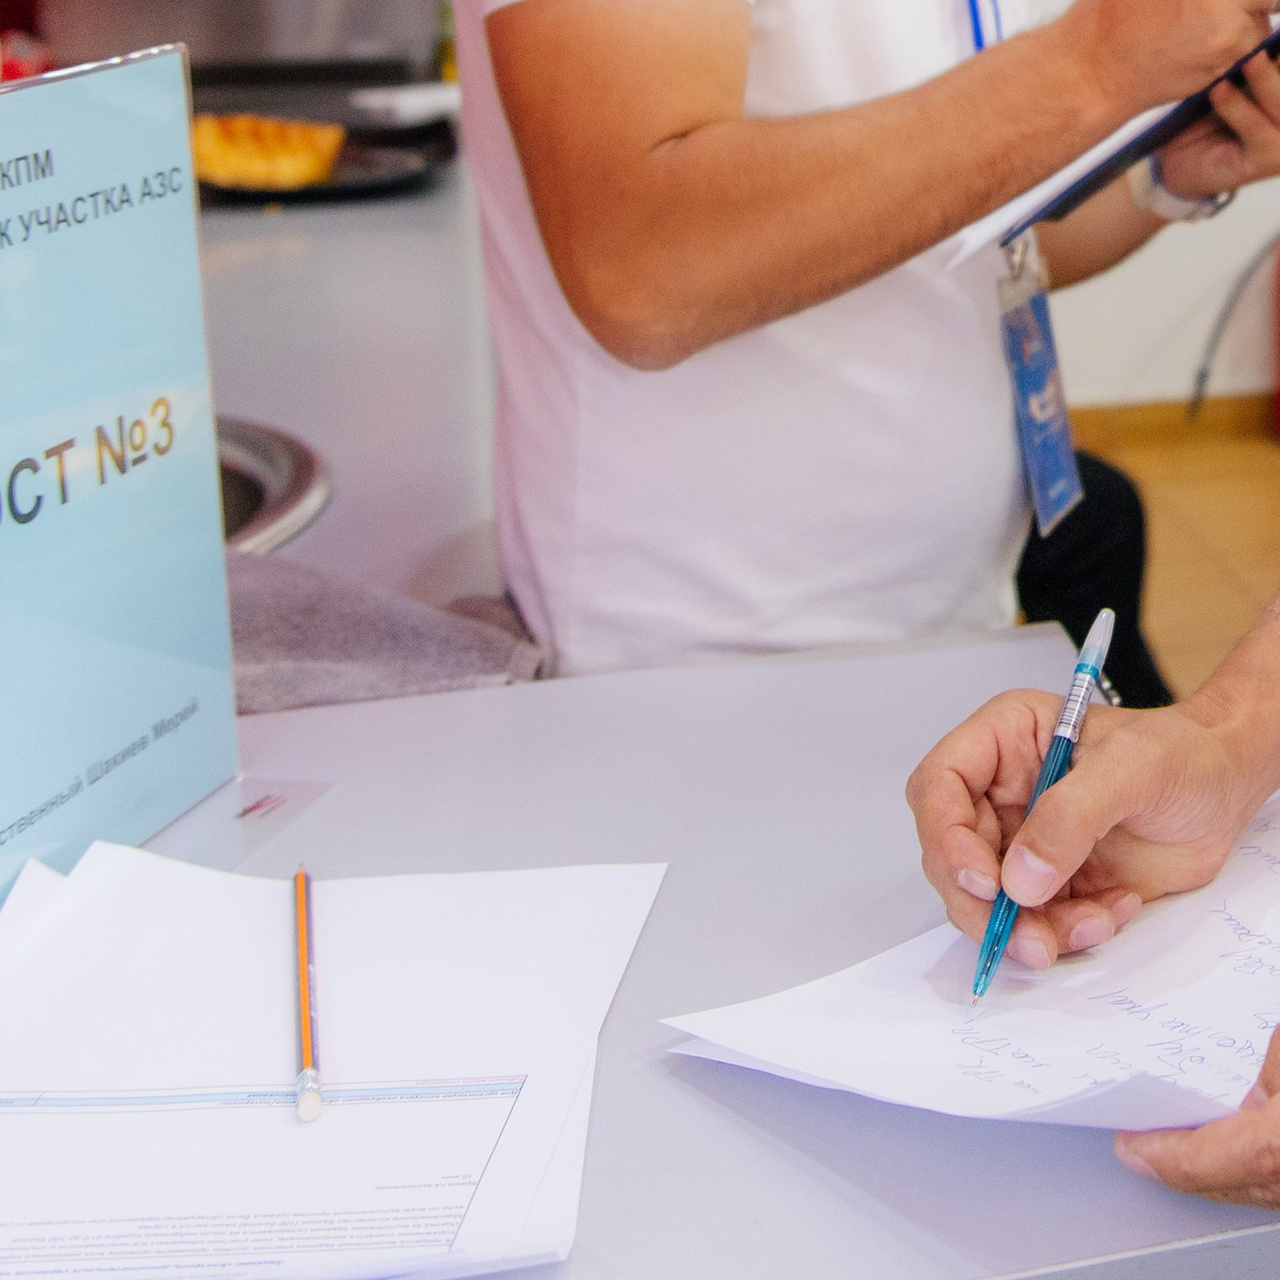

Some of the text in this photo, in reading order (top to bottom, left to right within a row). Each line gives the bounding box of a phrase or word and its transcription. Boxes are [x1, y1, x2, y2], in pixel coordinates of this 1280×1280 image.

[18, 184, 134, 242] УЧАСТКА
[139, 166, 183, 204] АЗС
[0, 396, 175, 528] СТ №3
